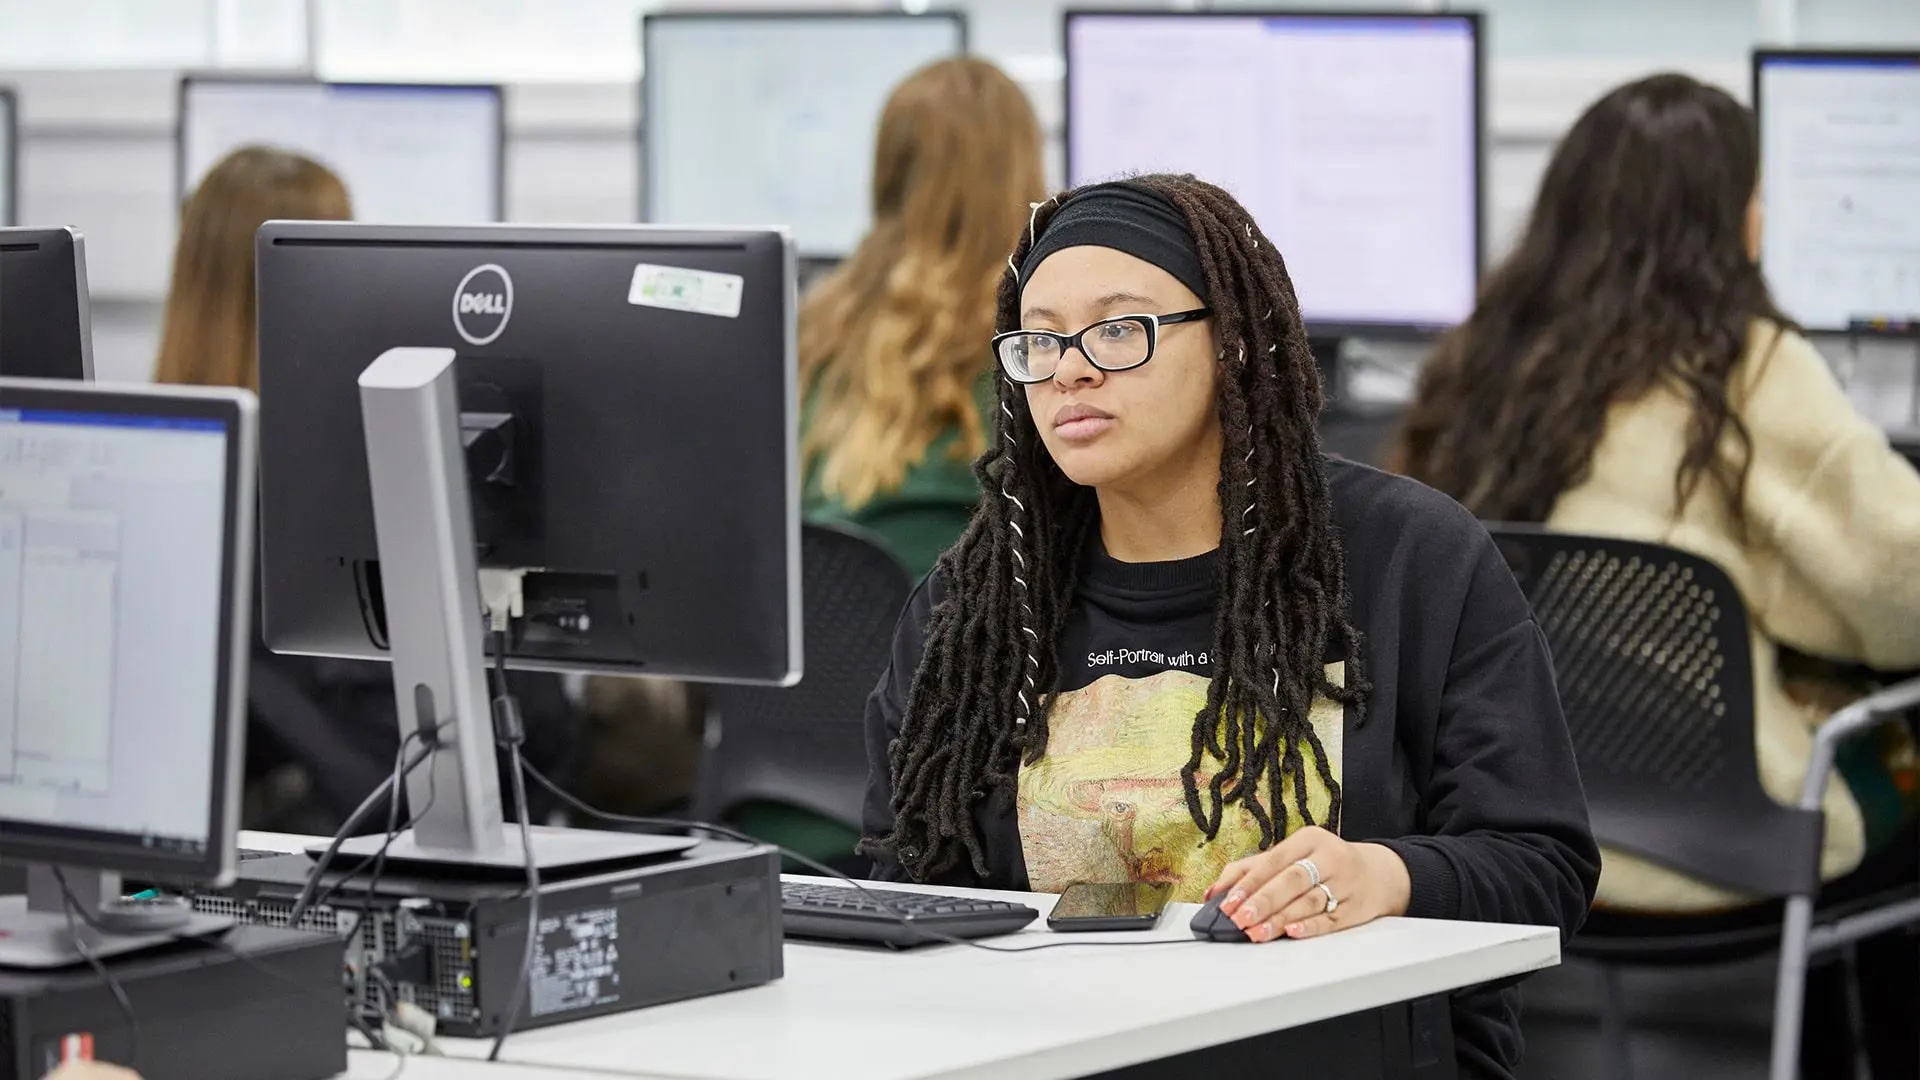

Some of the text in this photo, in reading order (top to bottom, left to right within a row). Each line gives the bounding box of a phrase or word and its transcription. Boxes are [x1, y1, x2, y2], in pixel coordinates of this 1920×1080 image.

[460, 293, 504, 314] DELL
[1087, 648, 1165, 667] Self-Portrait
[1167, 650, 1195, 667] with
[1198, 652, 1208, 665] a
